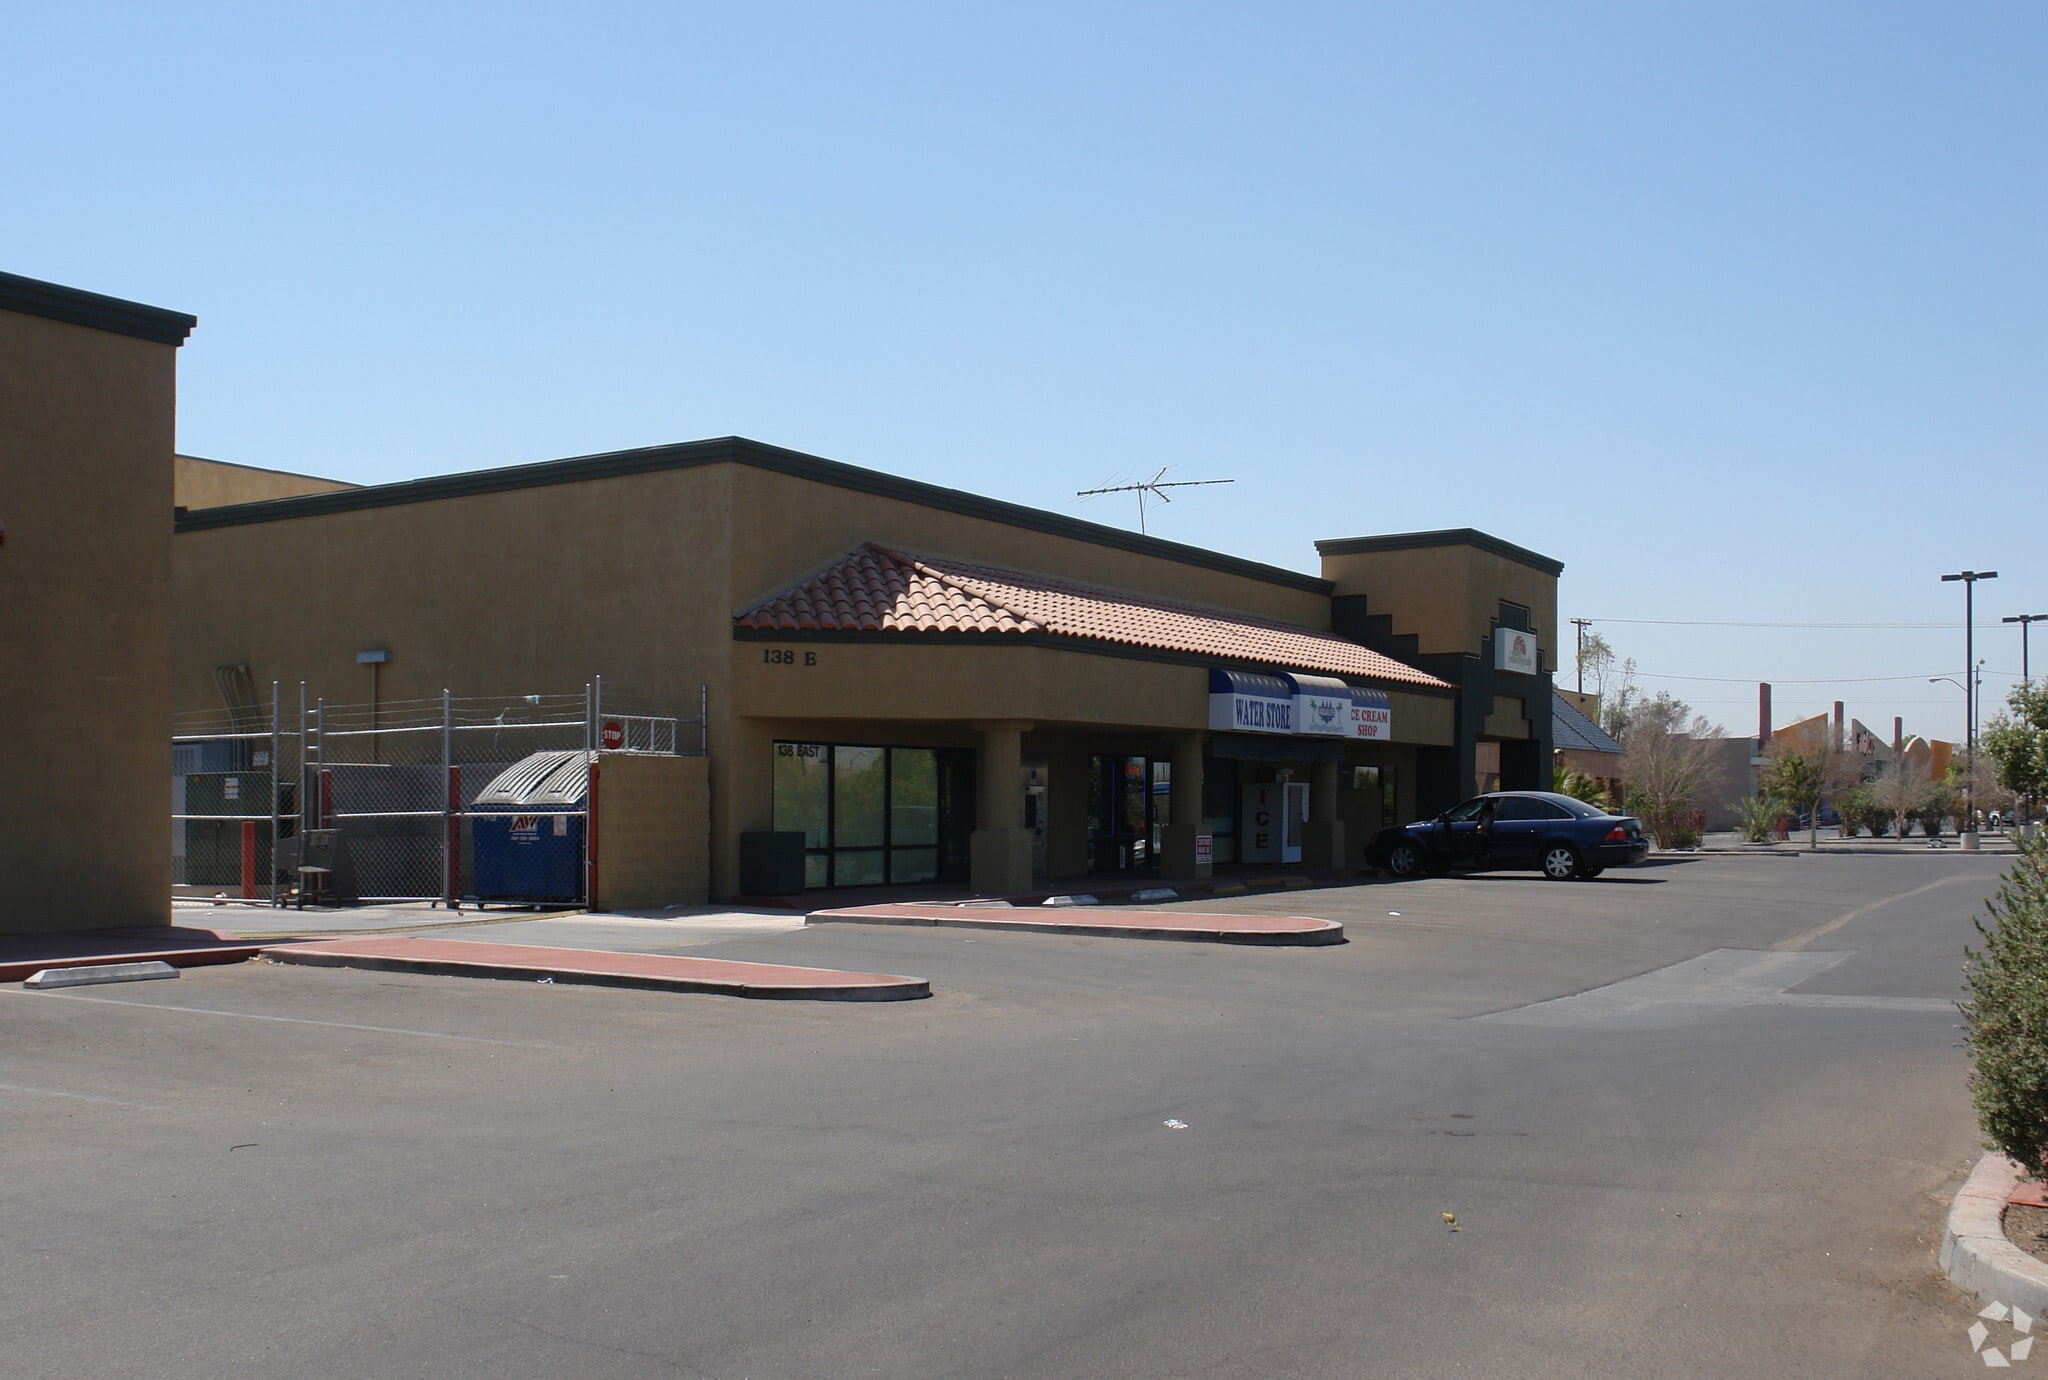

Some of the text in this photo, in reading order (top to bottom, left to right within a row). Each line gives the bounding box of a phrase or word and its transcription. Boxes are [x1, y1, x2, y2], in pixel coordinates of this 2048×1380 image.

[763, 649, 816, 666] 138 E
[1235, 699, 1291, 729] WATER STORE
[1351, 709, 1388, 723] CE CREAM
[603, 730, 621, 740] STOP
[1357, 724, 1378, 737] SHOP
[777, 744, 820, 758] 138 EAST
[1255, 788, 1270, 849] ICE
